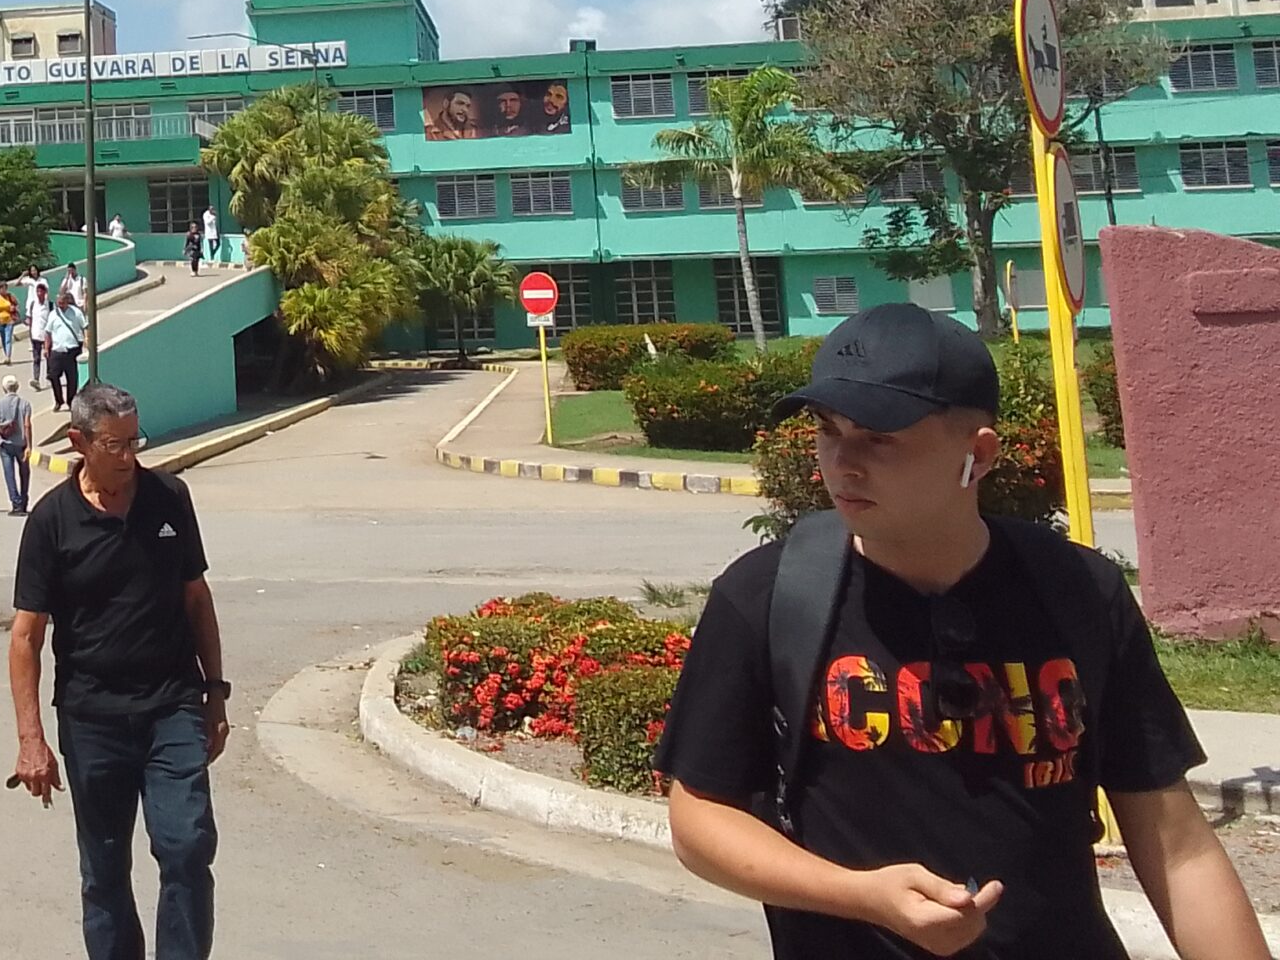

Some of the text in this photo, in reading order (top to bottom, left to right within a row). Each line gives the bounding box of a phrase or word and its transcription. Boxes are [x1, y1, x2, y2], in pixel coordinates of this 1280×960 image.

[48, 58, 154, 78] GUEVARA
[172, 54, 201, 72] DE
[221, 51, 249, 69] LA
[268, 47, 346, 67] SERNA
